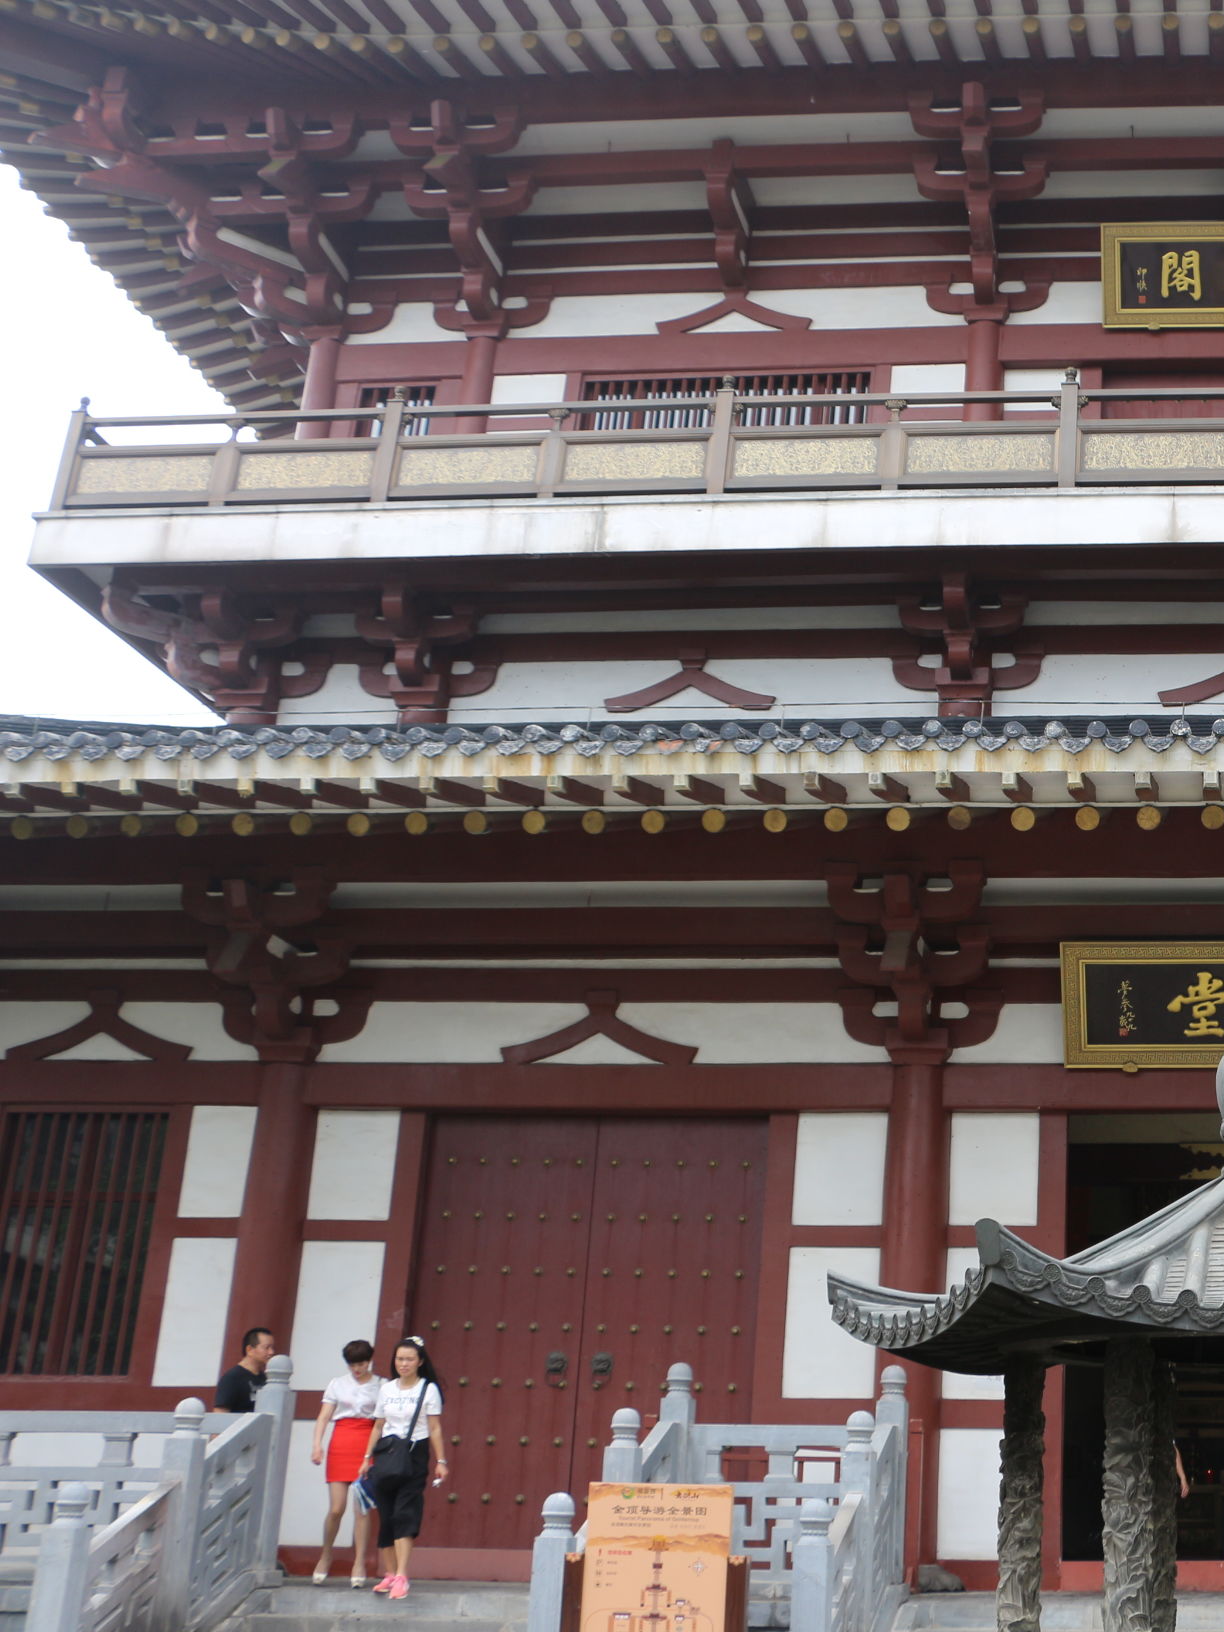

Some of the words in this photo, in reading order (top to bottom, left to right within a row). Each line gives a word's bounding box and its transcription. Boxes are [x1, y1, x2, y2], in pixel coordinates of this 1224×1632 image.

[611, 1504, 707, 1516] 金顶导游全景图
